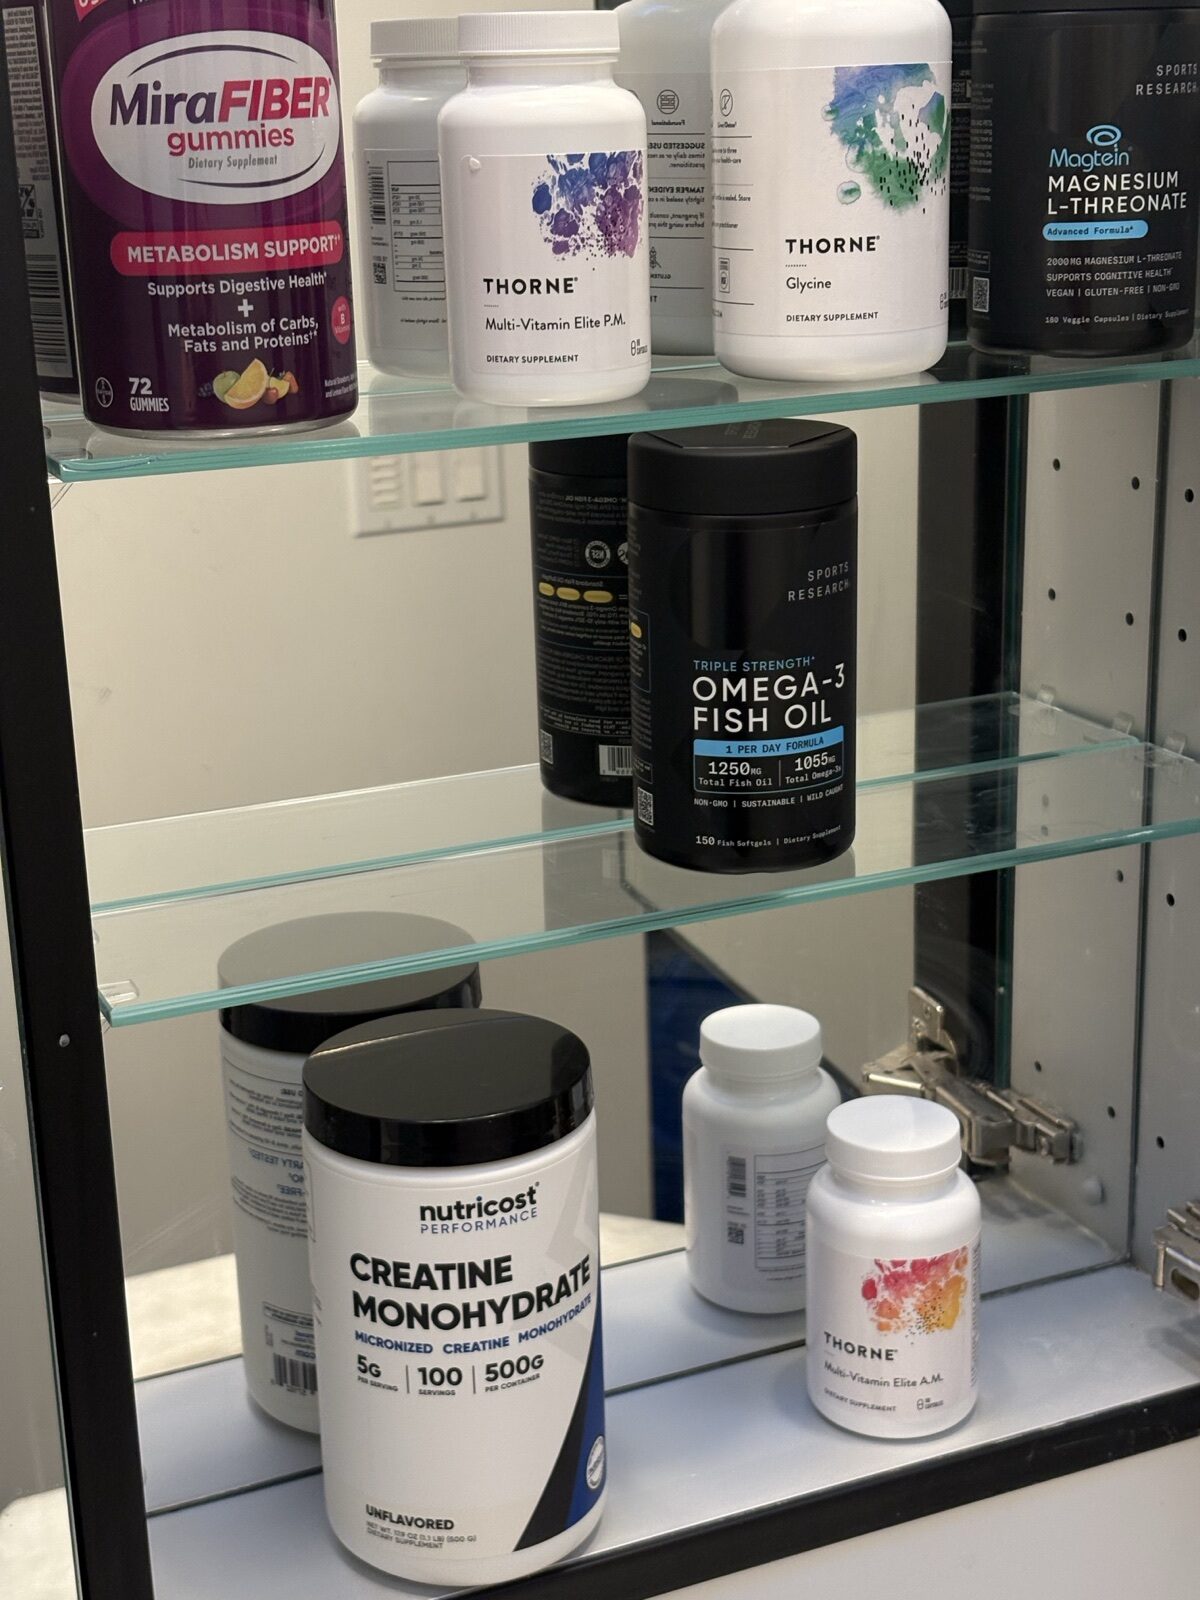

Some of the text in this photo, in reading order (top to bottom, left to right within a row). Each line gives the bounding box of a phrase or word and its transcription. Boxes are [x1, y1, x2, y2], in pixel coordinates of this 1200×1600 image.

[1156, 63, 1198, 78] SPORTS
[1136, 81, 1199, 96] RESEARCH
[167, 124, 295, 156] gummies
[188, 154, 278, 171] Dietary Supplement
[1048, 171, 1179, 193] MAGNESIUM
[1048, 192, 1187, 215] L-THREONATE
[1047, 227, 1089, 238] Advanced
[127, 243, 259, 263] METABOLISM
[1084, 255, 1135, 265] MAGNESIUM
[1046, 272, 1092, 282] SUPPORTS
[1094, 270, 1143, 281] COGNITIVE
[147, 281, 215, 298] Supports
[219, 277, 285, 296] Digestive
[786, 277, 832, 294] Glycine
[1046, 288, 1074, 298] VEGAN
[1084, 285, 1144, 297] GLUTEN-FREE
[485, 313, 626, 332] Multi-Vitamin Elite P.M.
[786, 311, 879, 323] DIETARY SUPPLEMENT
[168, 315, 319, 339] Metabolism of Carbs,
[184, 338, 217, 353] Fats
[221, 337, 249, 352] and
[486, 353, 579, 364] DIETARY SUPPLEMENT
[128, 377, 153, 395] 72
[130, 397, 170, 412] GUMMIES
[807, 561, 849, 582] SPORTS
[788, 578, 849, 602] RESEARCH
[693, 659, 738, 672] TRIPLE
[692, 662, 845, 703] OMEGA-3
[693, 699, 832, 733] FISH OIL
[737, 744, 757, 754] PER
[762, 743, 781, 753] DAY
[786, 736, 825, 750] FORMULA
[698, 777, 725, 786] Total
[729, 778, 752, 787] Fish
[756, 777, 773, 787] Oil
[785, 774, 809, 785] Total
[741, 796, 796, 808] SUSTAINABLE
[695, 835, 715, 846] 150
[421, 1207, 538, 1234] PERFORMANCE
[350, 1253, 513, 1291] CREATINE
[352, 1254, 591, 1331] MONOHYDRATE
[355, 1293, 592, 1354] MICRONIZED CREATINE MONOHYDRATE
[357, 1354, 544, 1387] 5G 100 500G
[824, 1361, 890, 1388] Multi-Vitamin
[893, 1377, 917, 1388] Elite
[357, 1376, 369, 1385] PER
[370, 1379, 398, 1392] SERVING
[485, 1385, 499, 1393] PER
[500, 1373, 540, 1390] CONTAINER
[366, 1504, 454, 1530] UNFLAVORED
[395, 1537, 443, 1549] SUPPLEMENT
[406, 1533, 418, 1541] OZ
